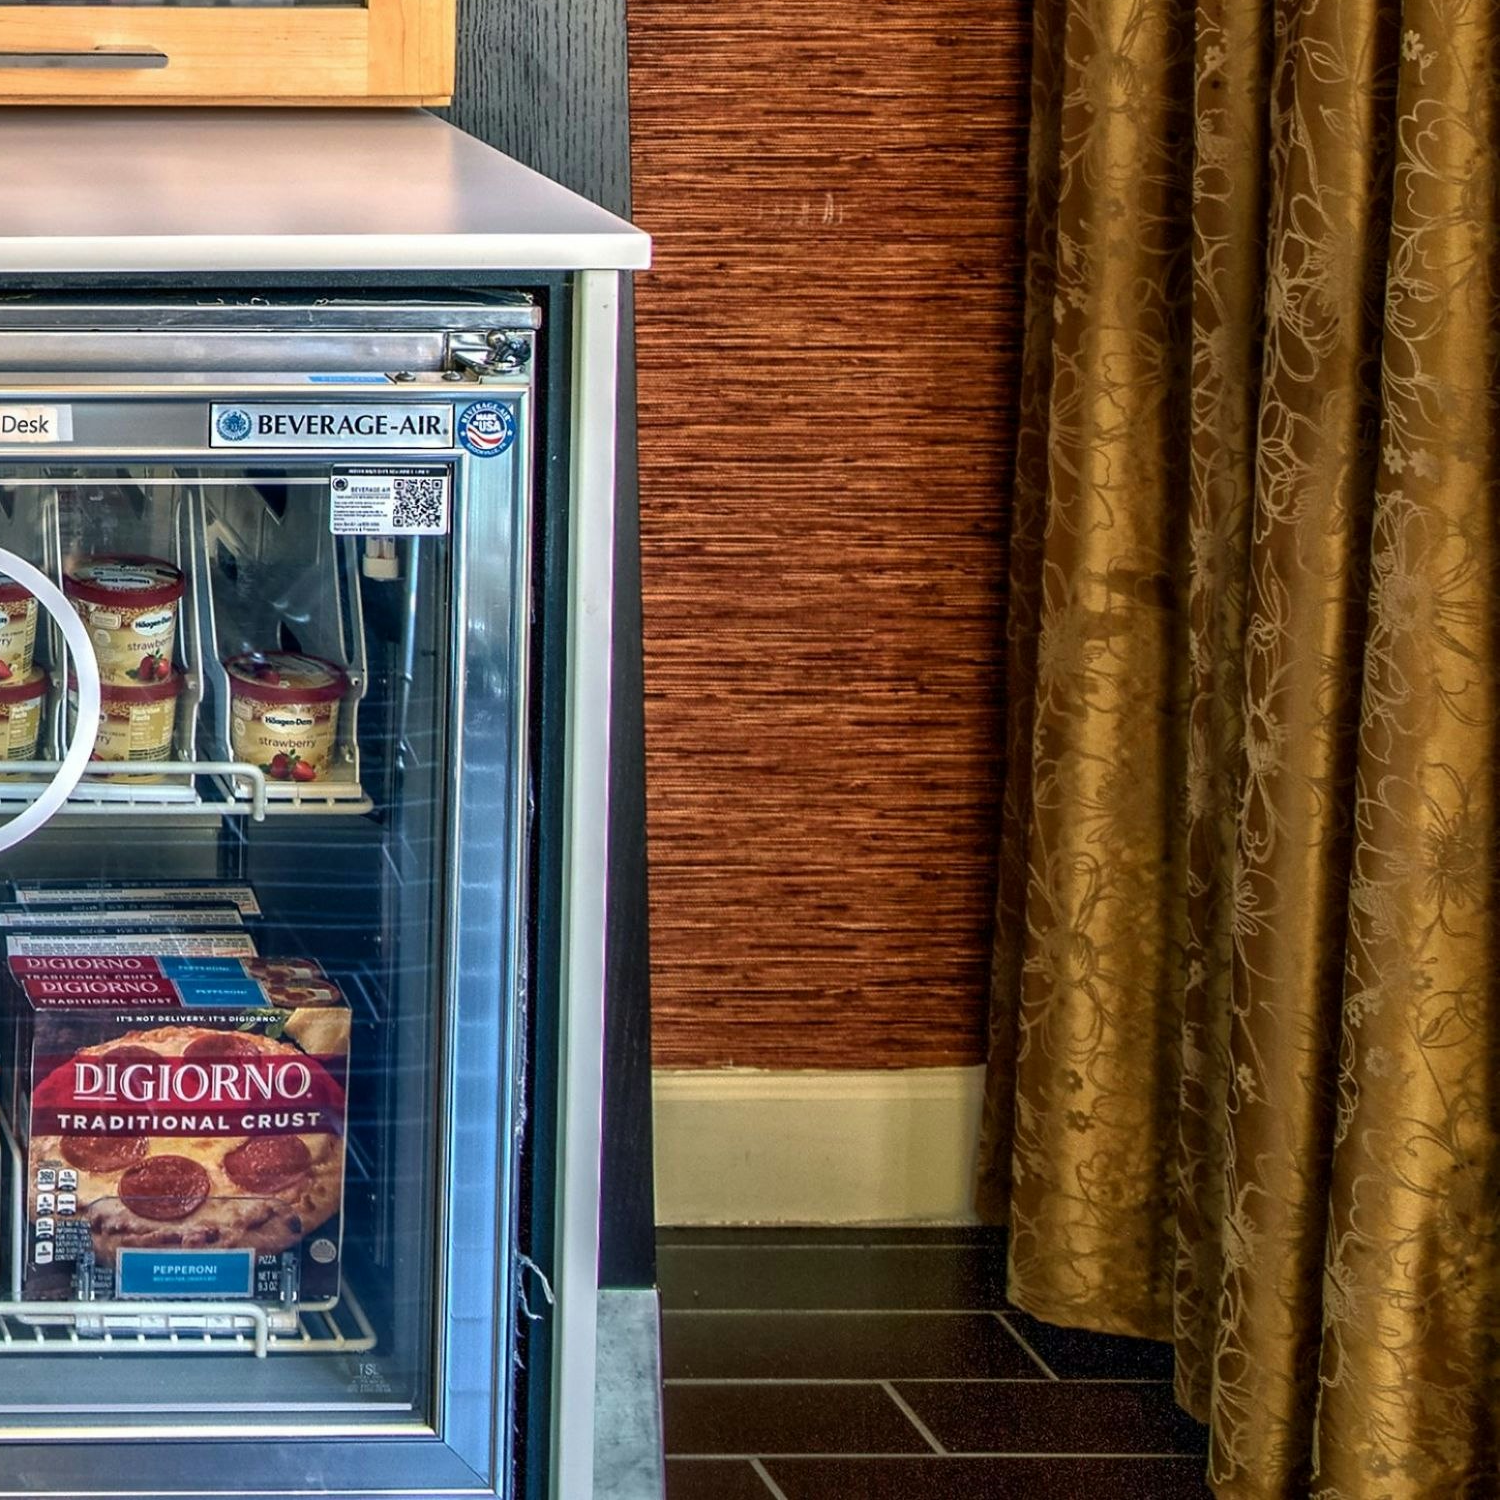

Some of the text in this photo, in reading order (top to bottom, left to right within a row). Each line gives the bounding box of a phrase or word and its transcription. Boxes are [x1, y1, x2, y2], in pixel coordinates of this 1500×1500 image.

[1, 414, 49, 435] Desk
[258, 414, 441, 436] BEVERAGE-AIR
[258, 736, 316, 749] strawberry
[40, 981, 160, 994] DIGIORNO
[131, 997, 172, 1005] CRUST
[73, 1061, 310, 1102] DIGIORNO
[57, 1111, 321, 1131] TRADITIONAL CRUST
[153, 1264, 217, 1275] PEPPERONI
